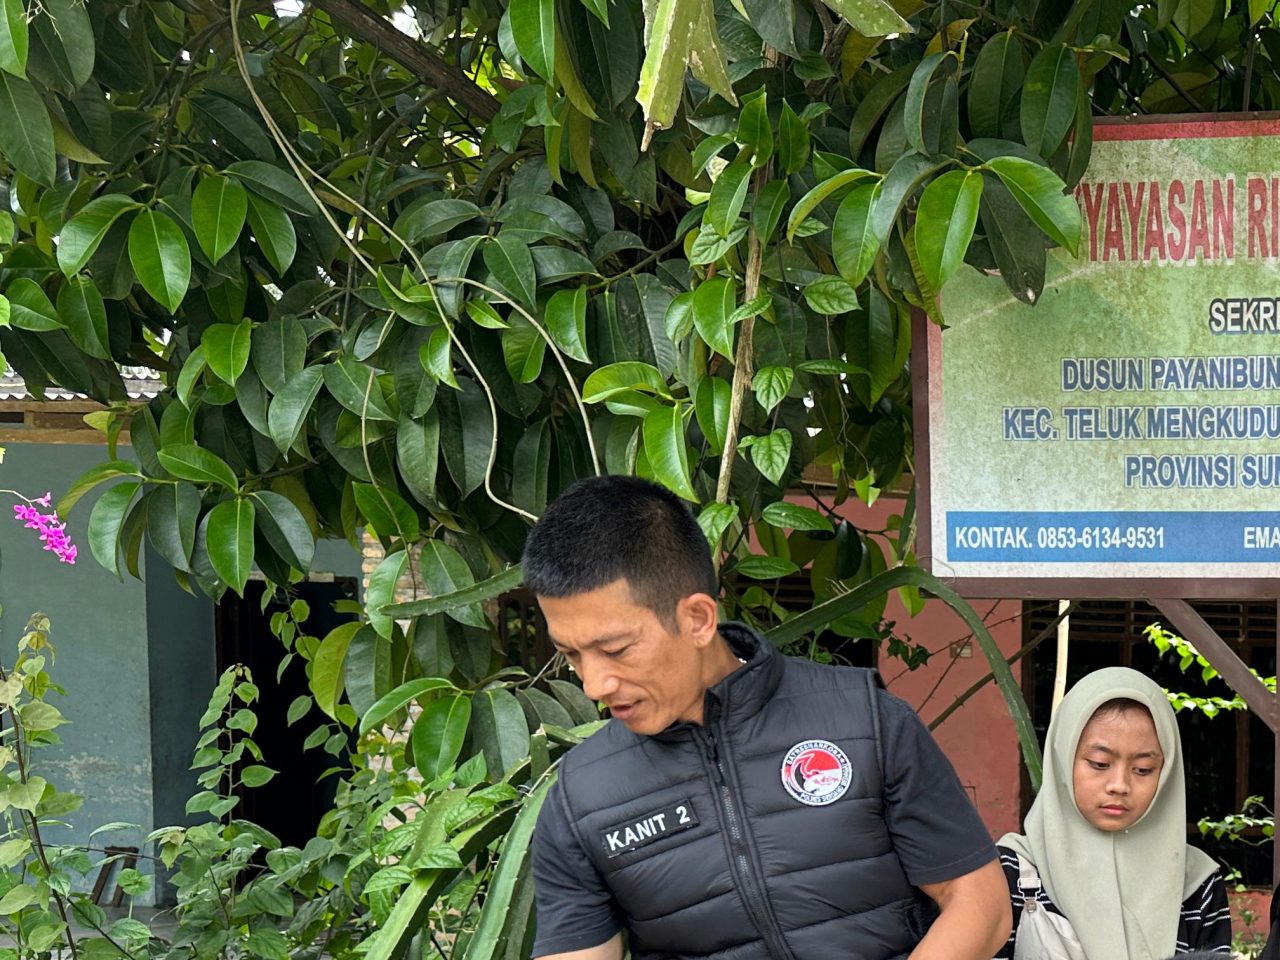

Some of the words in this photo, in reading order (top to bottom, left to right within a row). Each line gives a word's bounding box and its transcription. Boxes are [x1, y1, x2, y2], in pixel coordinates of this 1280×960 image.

[1062, 357, 1144, 391] DUSUN
[1003, 407, 1058, 439] KEC.
[1063, 406, 1143, 439] TELUK
[1125, 454, 1237, 487] PROVINSI
[955, 526, 1033, 549] KONTAK.
[1037, 526, 1164, 549] 0853-6134-9531
[605, 813, 666, 851] KANIT
[675, 805, 691, 825] 2
